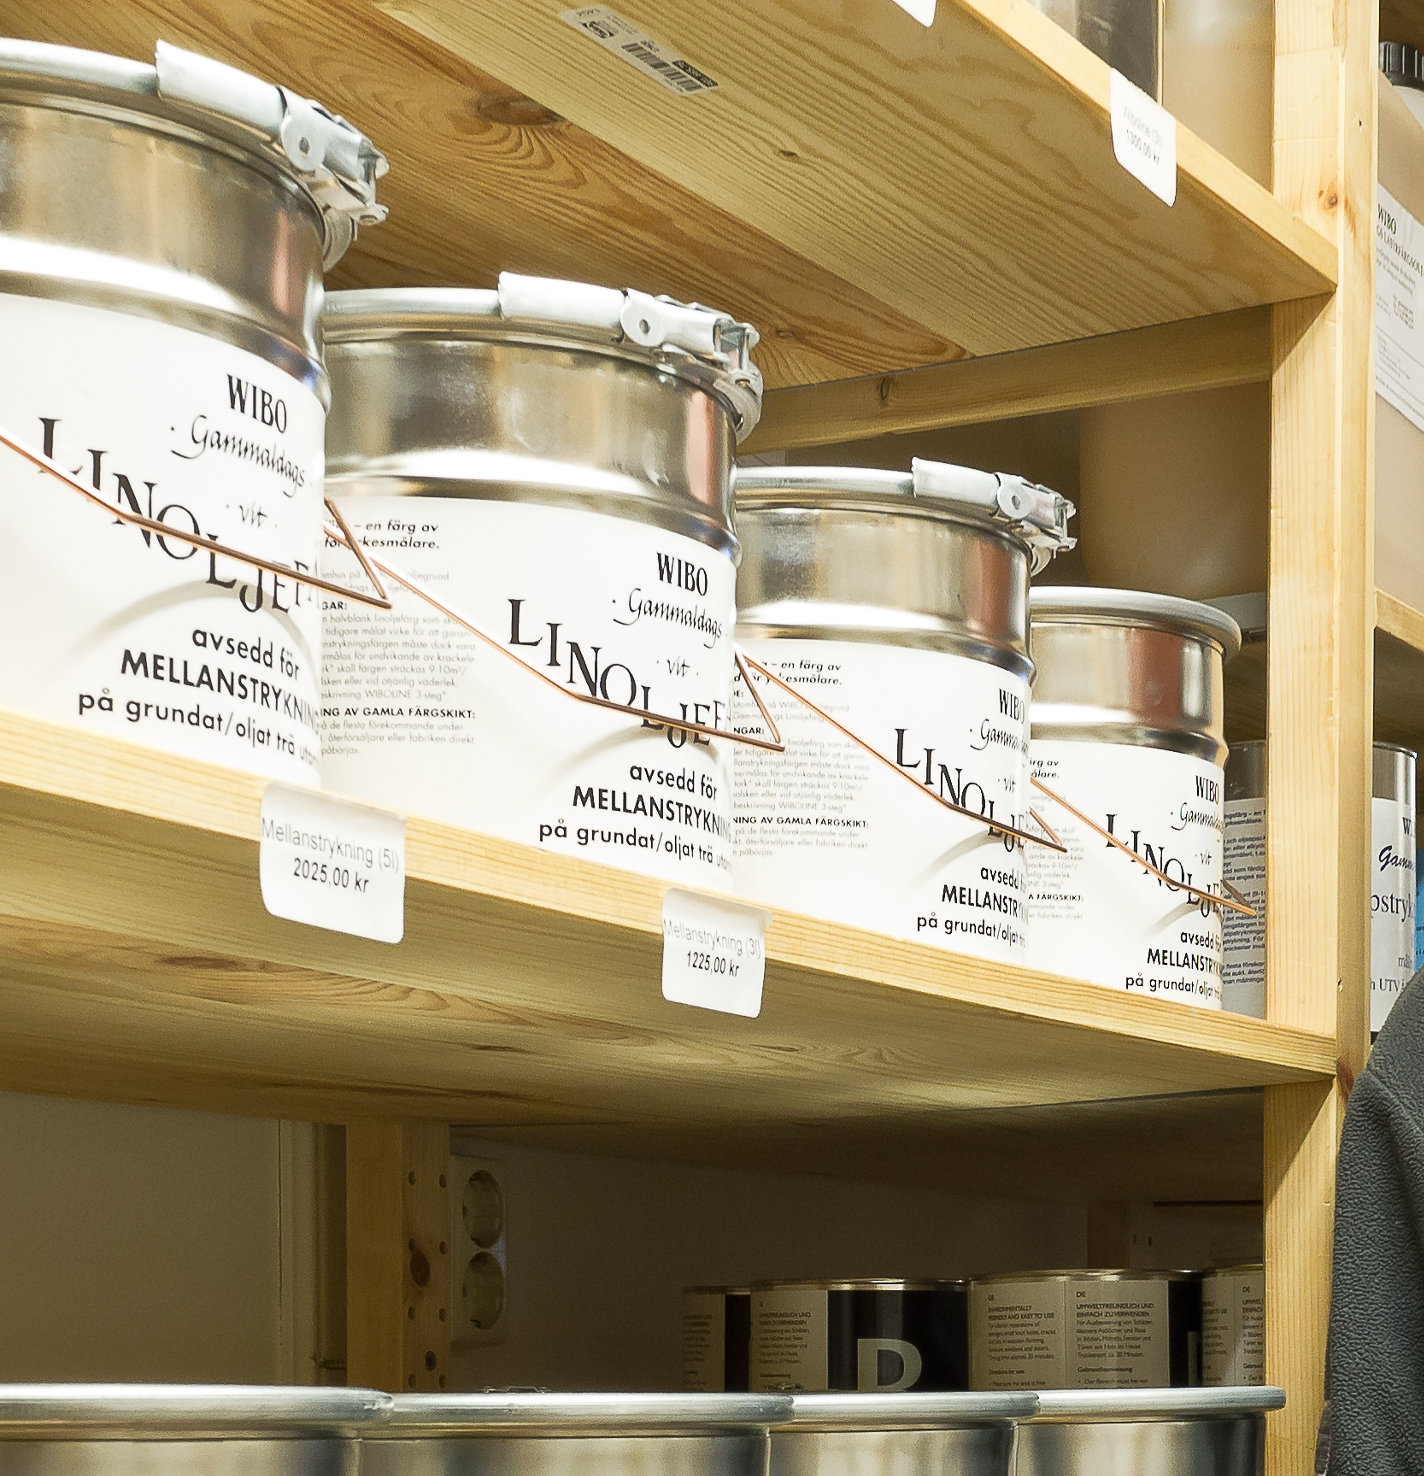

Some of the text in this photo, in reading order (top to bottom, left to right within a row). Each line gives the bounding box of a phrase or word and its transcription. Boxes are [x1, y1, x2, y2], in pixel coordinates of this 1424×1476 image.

[227, 374, 288, 434] WIBO
[171, 414, 305, 498] Gammaldags
[239, 501, 268, 527] vit
[388, 519, 415, 534] färg
[656, 552, 708, 597] WIBO
[612, 588, 723, 649] Gammaldags
[192, 629, 300, 681] avsedd för
[666, 656, 690, 679] vit
[800, 660, 823, 672] färg
[79, 688, 295, 757] på grundat/oljat trä
[344, 705, 475, 720] AV GAMLA FÄRGSKIKT:
[629, 764, 717, 801] avsedd för
[761, 816, 869, 829] AV GAMLA FÄRGSKIKT:
[262, 818, 399, 874] Mellanstrykning (5l)
[539, 818, 713, 865] på grundat/oljat trä
[293, 858, 369, 893] 2025,00 kr
[980, 866, 1019, 890] avsedd
[1036, 893, 1084, 902] FÄRGSKIKT:
[917, 912, 938, 932] på
[664, 919, 760, 960] Mellanstrykning (3l)
[1180, 930, 1215, 950] avsedd
[687, 950, 739, 977] 1225,00 kr
[1125, 972, 1144, 990] på
